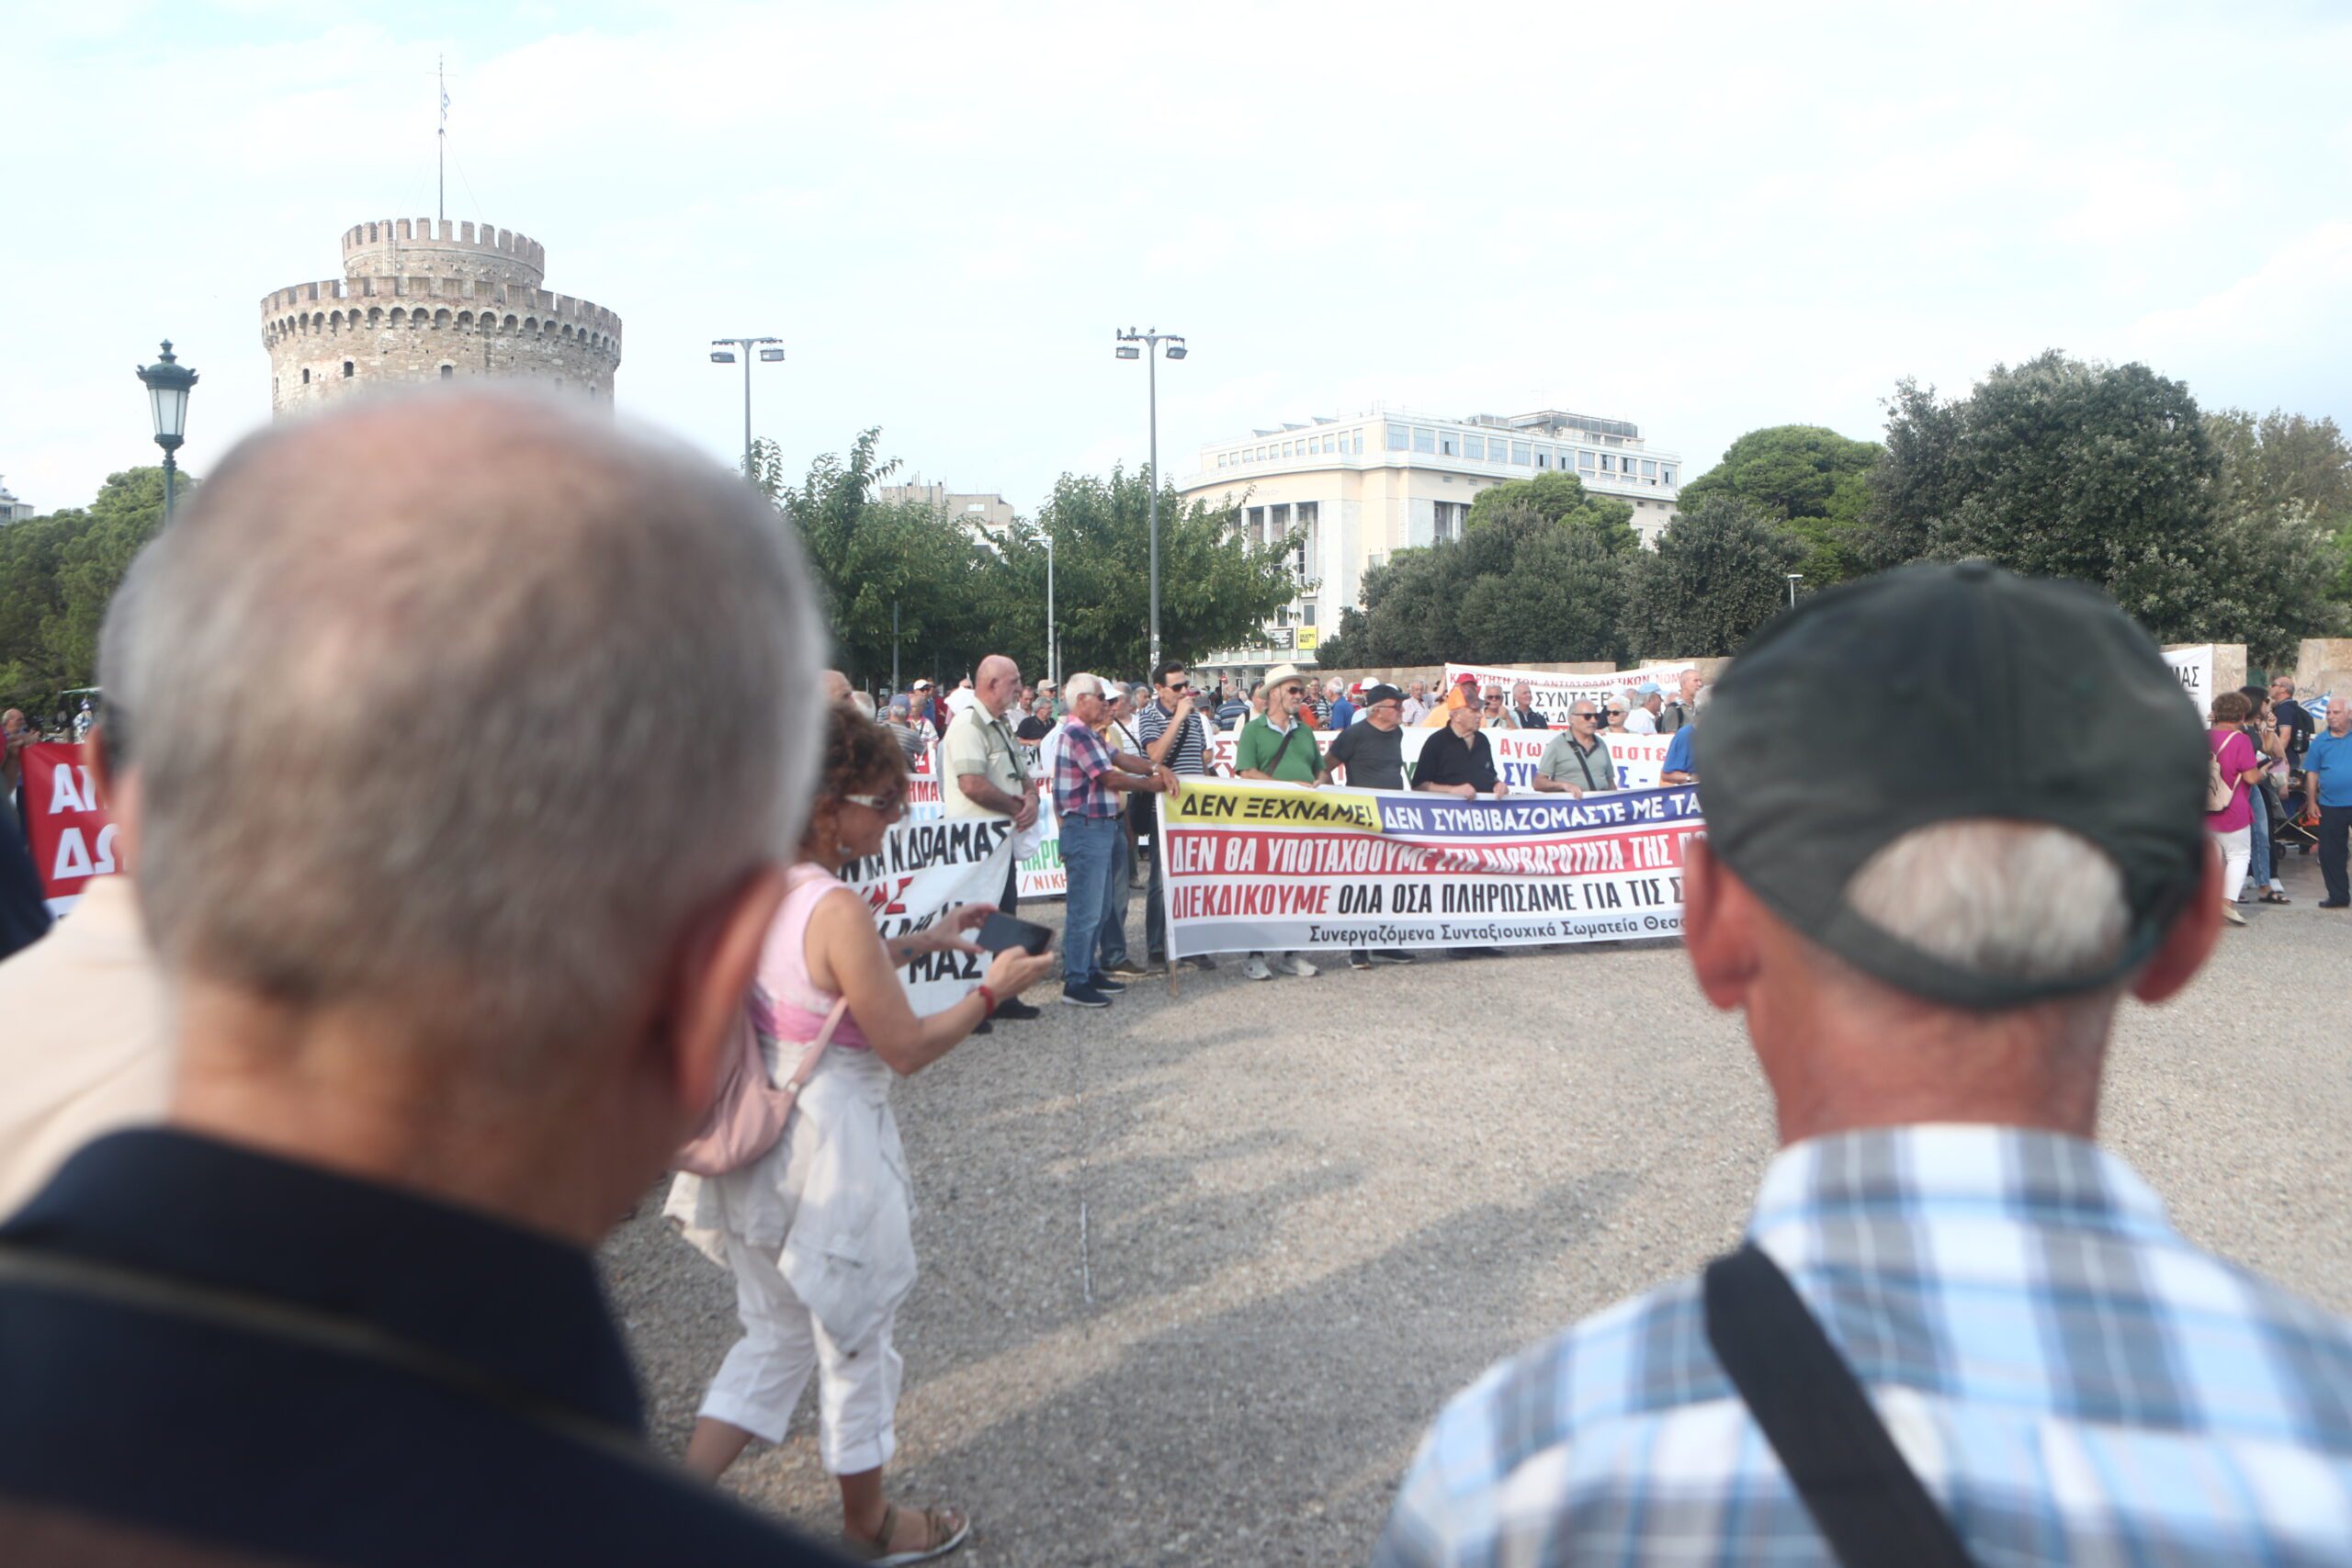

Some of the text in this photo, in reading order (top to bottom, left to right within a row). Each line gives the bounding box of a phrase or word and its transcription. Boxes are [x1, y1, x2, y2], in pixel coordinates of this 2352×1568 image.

[1181, 794, 1374, 827] ΔΕΝ ΞΕΧΝΑΜΕ!
[1385, 807, 1424, 830] ΔΕΝ
[1430, 802, 1626, 831] ΣΥΜΒΙΒΑΖΟΜΑΣΤΕ
[1632, 796, 1664, 820] ΜΕ
[1171, 836, 1218, 873] ΔΕΝ
[1224, 837, 1257, 872] ΘΑ
[1267, 838, 1439, 873] ΥΠΟΤΑΧΘΟΥΜΕ
[1434, 848, 1481, 872] ΣΤΗ
[1481, 840, 1624, 874] ΒΑΡΒΑΡΟΤΗΤΑ
[1629, 834, 1673, 868] ΤΗΣ
[1171, 884, 1331, 919] ΔΙΕΚΔΙΚΟΥΜΕ
[1338, 884, 1382, 914] ΟΛΑ
[1392, 884, 1431, 914] ΟΣΑ
[1442, 883, 1577, 913] ΠΛΗΡΩΣΑΜΕ
[1582, 882, 1622, 909] ΓΙΑ
[1625, 878, 1665, 906] ΤΙΣ
[1308, 924, 1435, 946] Συνεργαζόμενα
[1440, 921, 1556, 942] Συνταξιουχικά
[1562, 918, 1638, 939] Σωματεία
